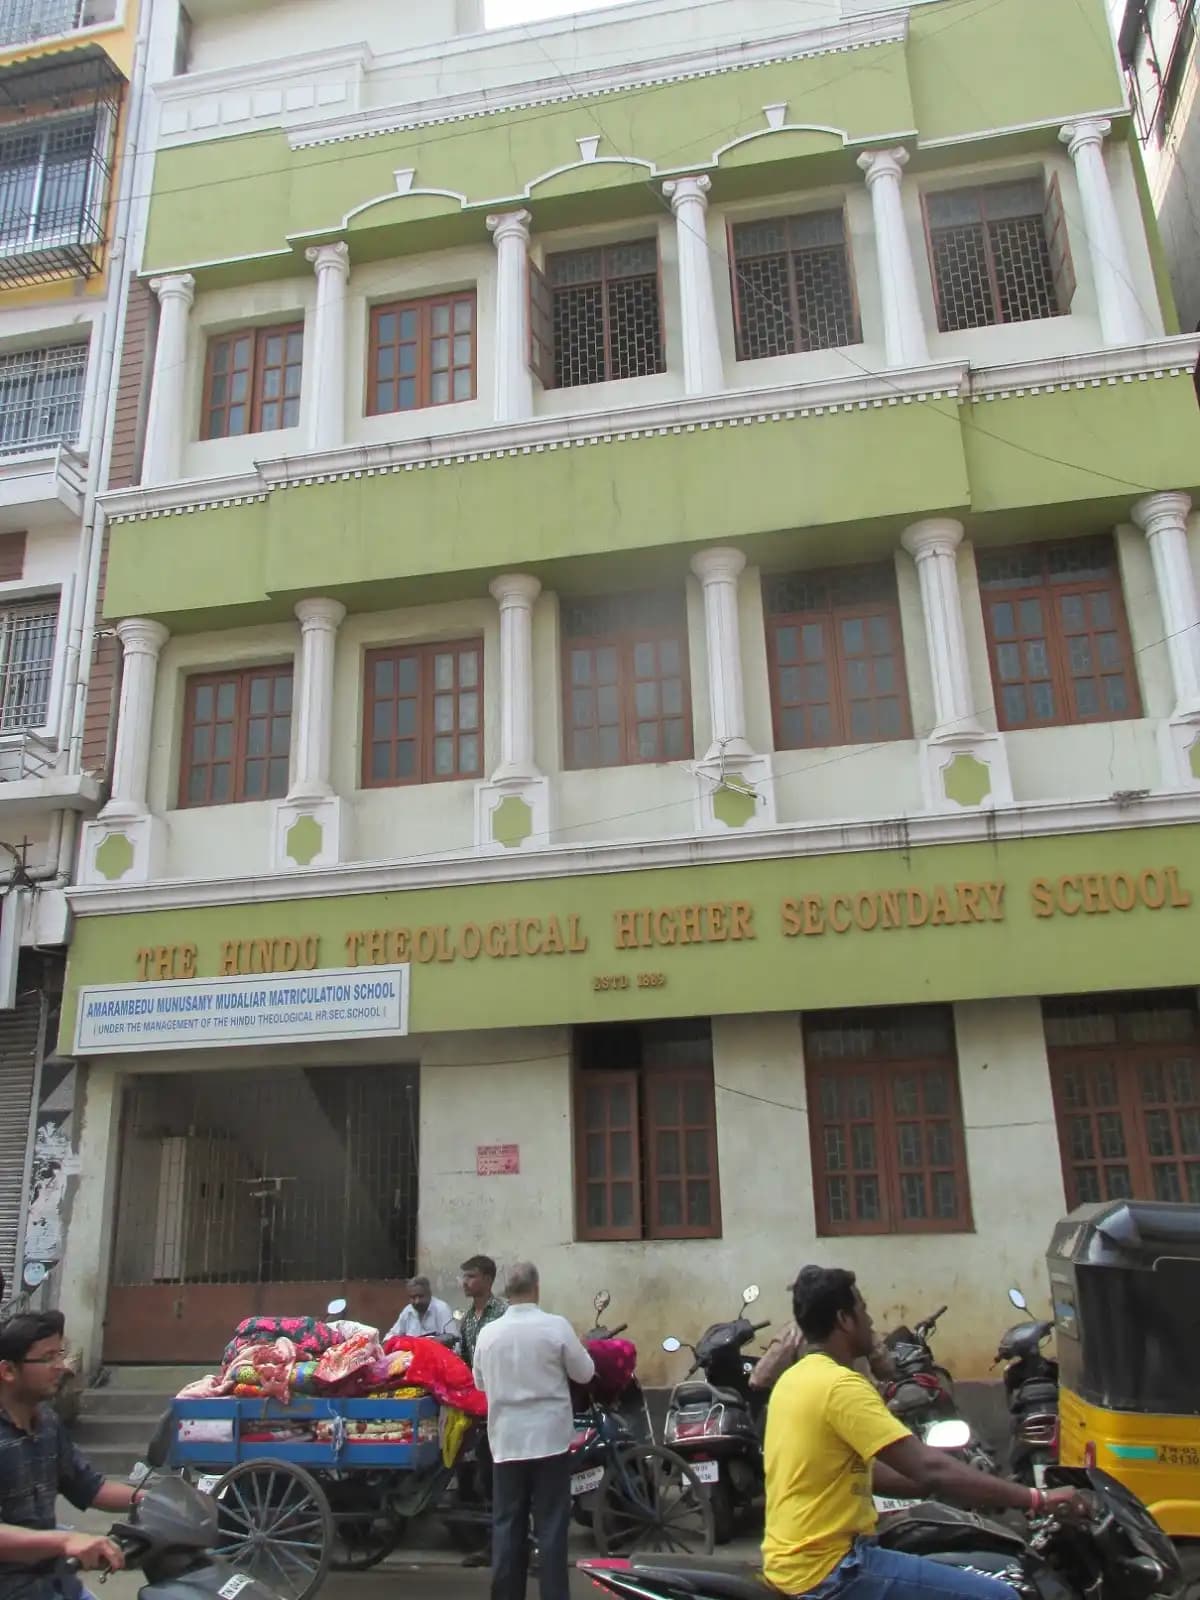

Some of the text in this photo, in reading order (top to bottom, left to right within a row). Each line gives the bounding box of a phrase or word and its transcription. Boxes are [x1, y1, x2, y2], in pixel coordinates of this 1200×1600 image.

[136, 866, 1190, 982] THE HINDU THEOLOGICAL HIGHER SECONDARY SCHOOL
[86, 981, 395, 1018] AMARAMBEDU MUNUSAMY MUDALIAR MATRICULATION SCHOOL
[126, 1021, 141, 1032] THE
[143, 1018, 199, 1031] MANAGEMENT
[200, 1017, 211, 1028] OF
[213, 1016, 229, 1027] THE
[230, 1013, 256, 1026] HINDU
[258, 1010, 313, 1025] THEOLOGICAL
